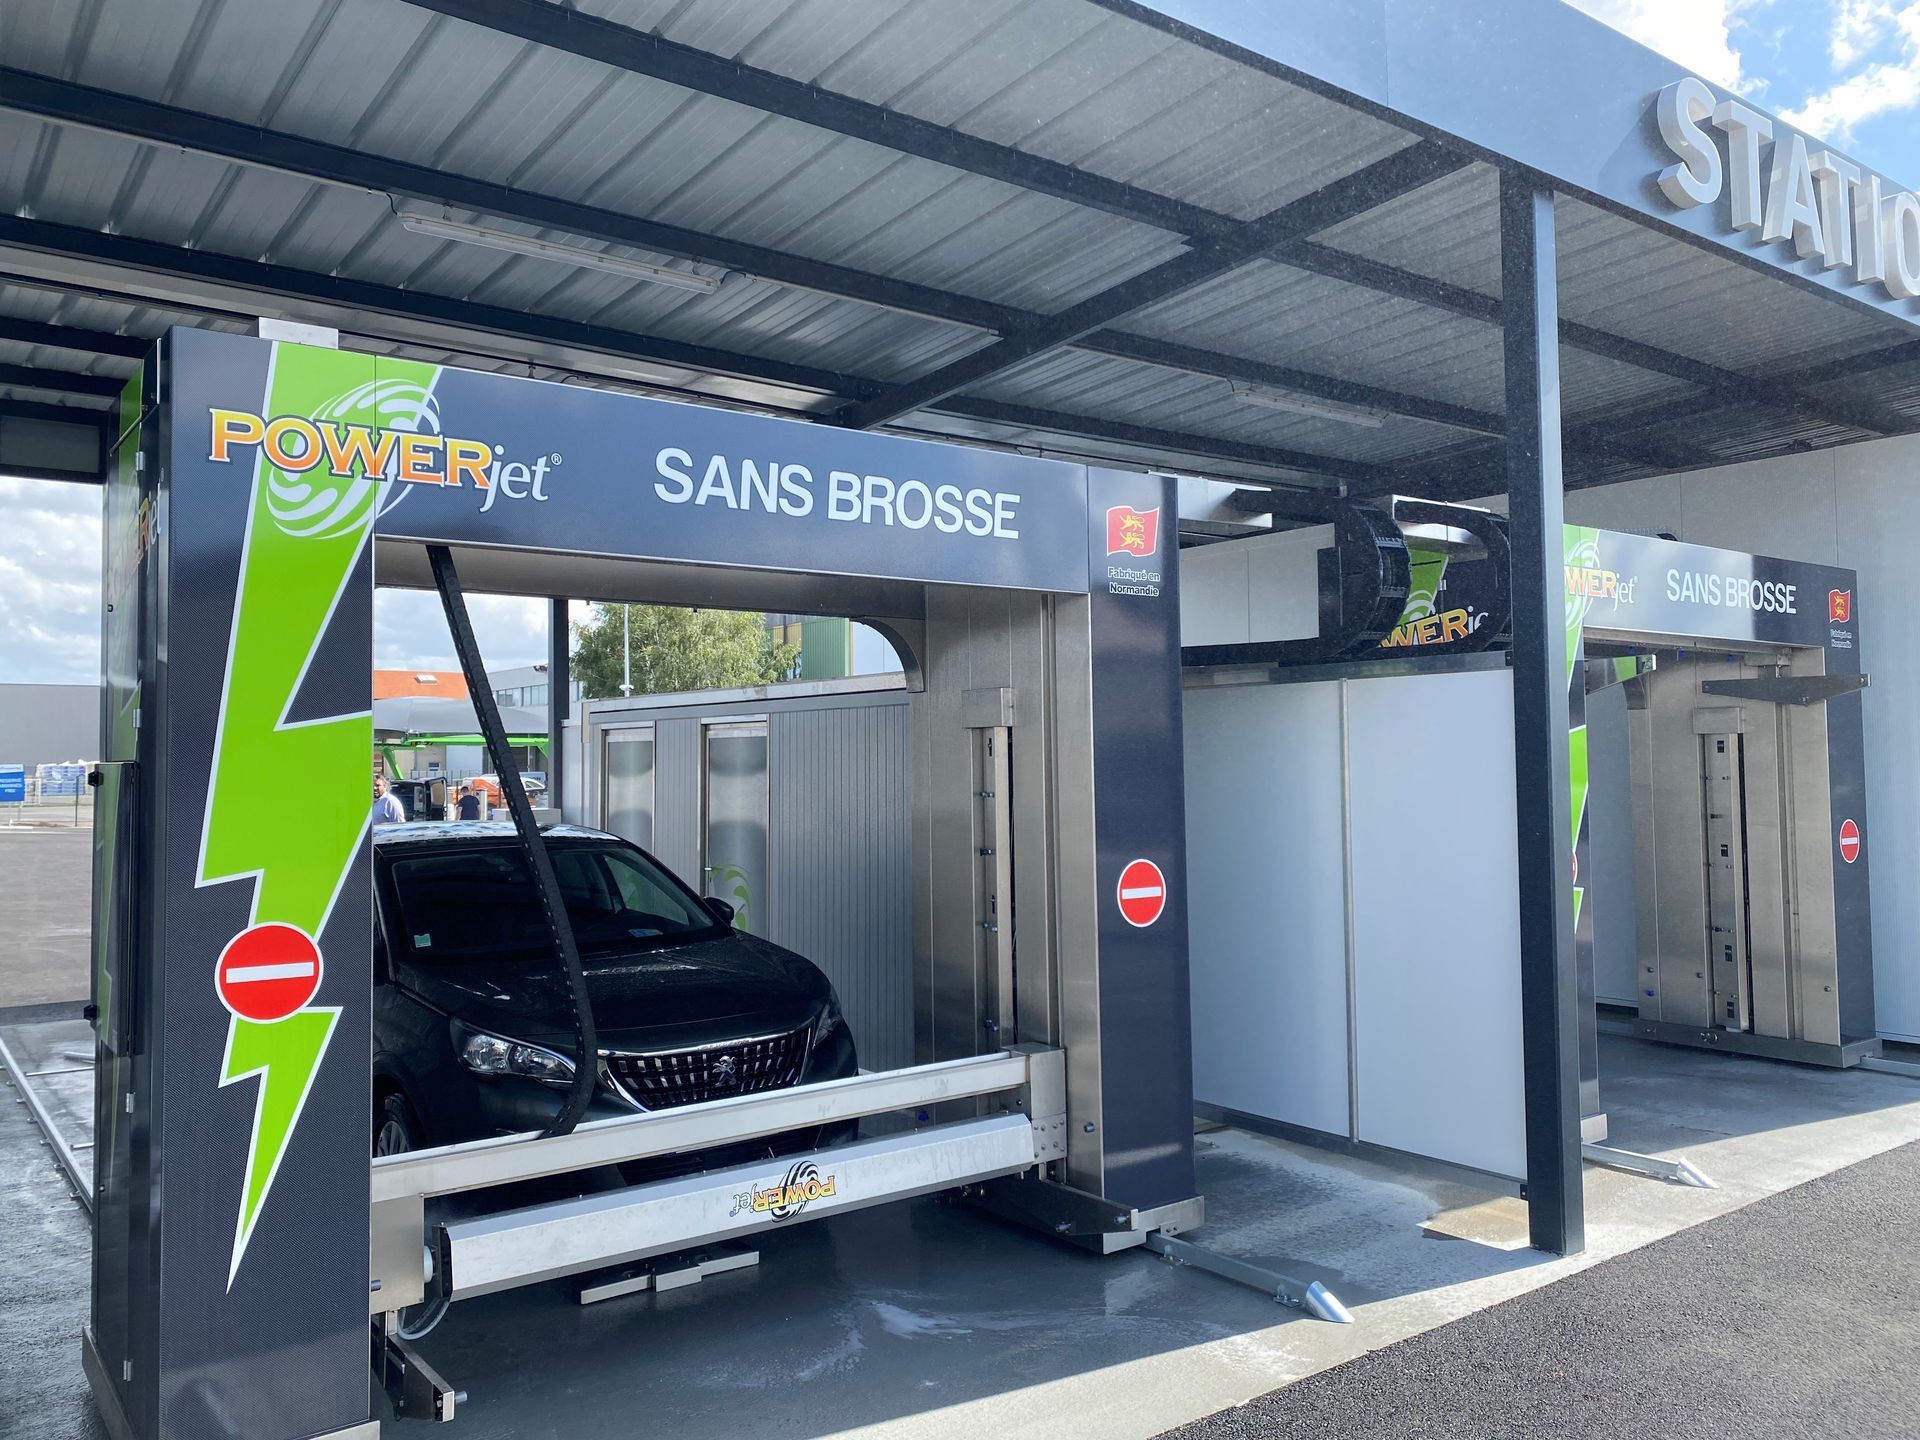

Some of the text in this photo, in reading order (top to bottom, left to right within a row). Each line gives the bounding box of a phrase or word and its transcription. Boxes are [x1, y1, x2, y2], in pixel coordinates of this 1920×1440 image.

[653, 447, 1021, 540] SANS BROSSE
[1107, 565, 1161, 583] Fabriqué en
[1109, 581, 1160, 597] Normandie
[1666, 568, 1797, 615] SANS BROSSE
